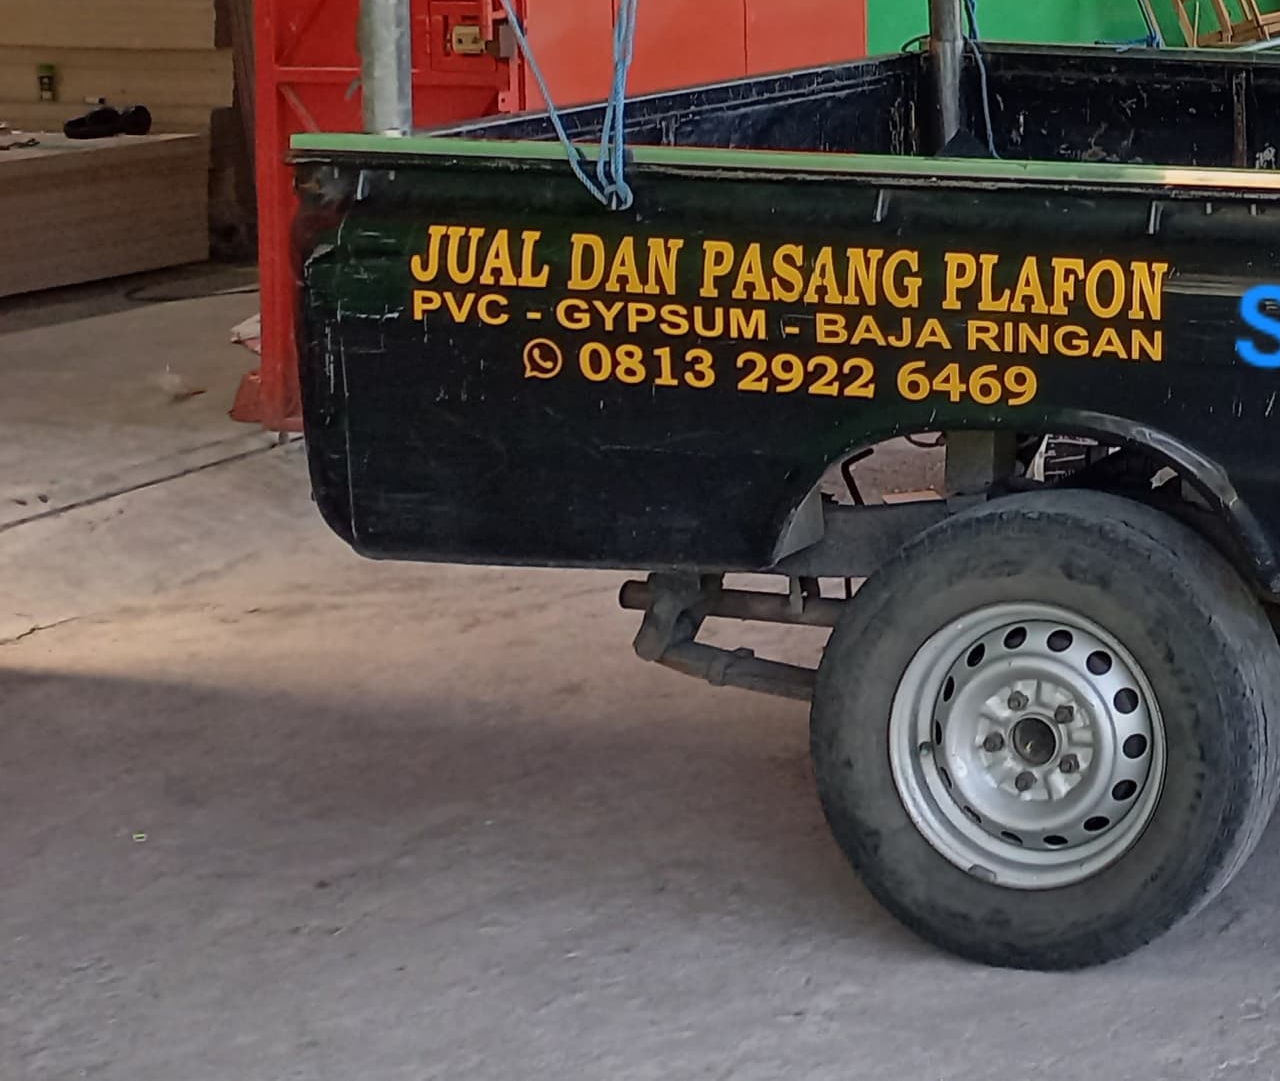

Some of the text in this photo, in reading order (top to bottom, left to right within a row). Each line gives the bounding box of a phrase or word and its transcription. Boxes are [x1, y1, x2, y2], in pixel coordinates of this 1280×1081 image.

[410, 224, 1169, 321] JUAL DAN PASANG PLAFON
[412, 289, 510, 325] PVC
[556, 298, 767, 341] GYPSUM
[815, 313, 955, 352] BAJA
[967, 320, 1163, 361] RINGAN
[578, 340, 1038, 406] 0813 2922 6469
